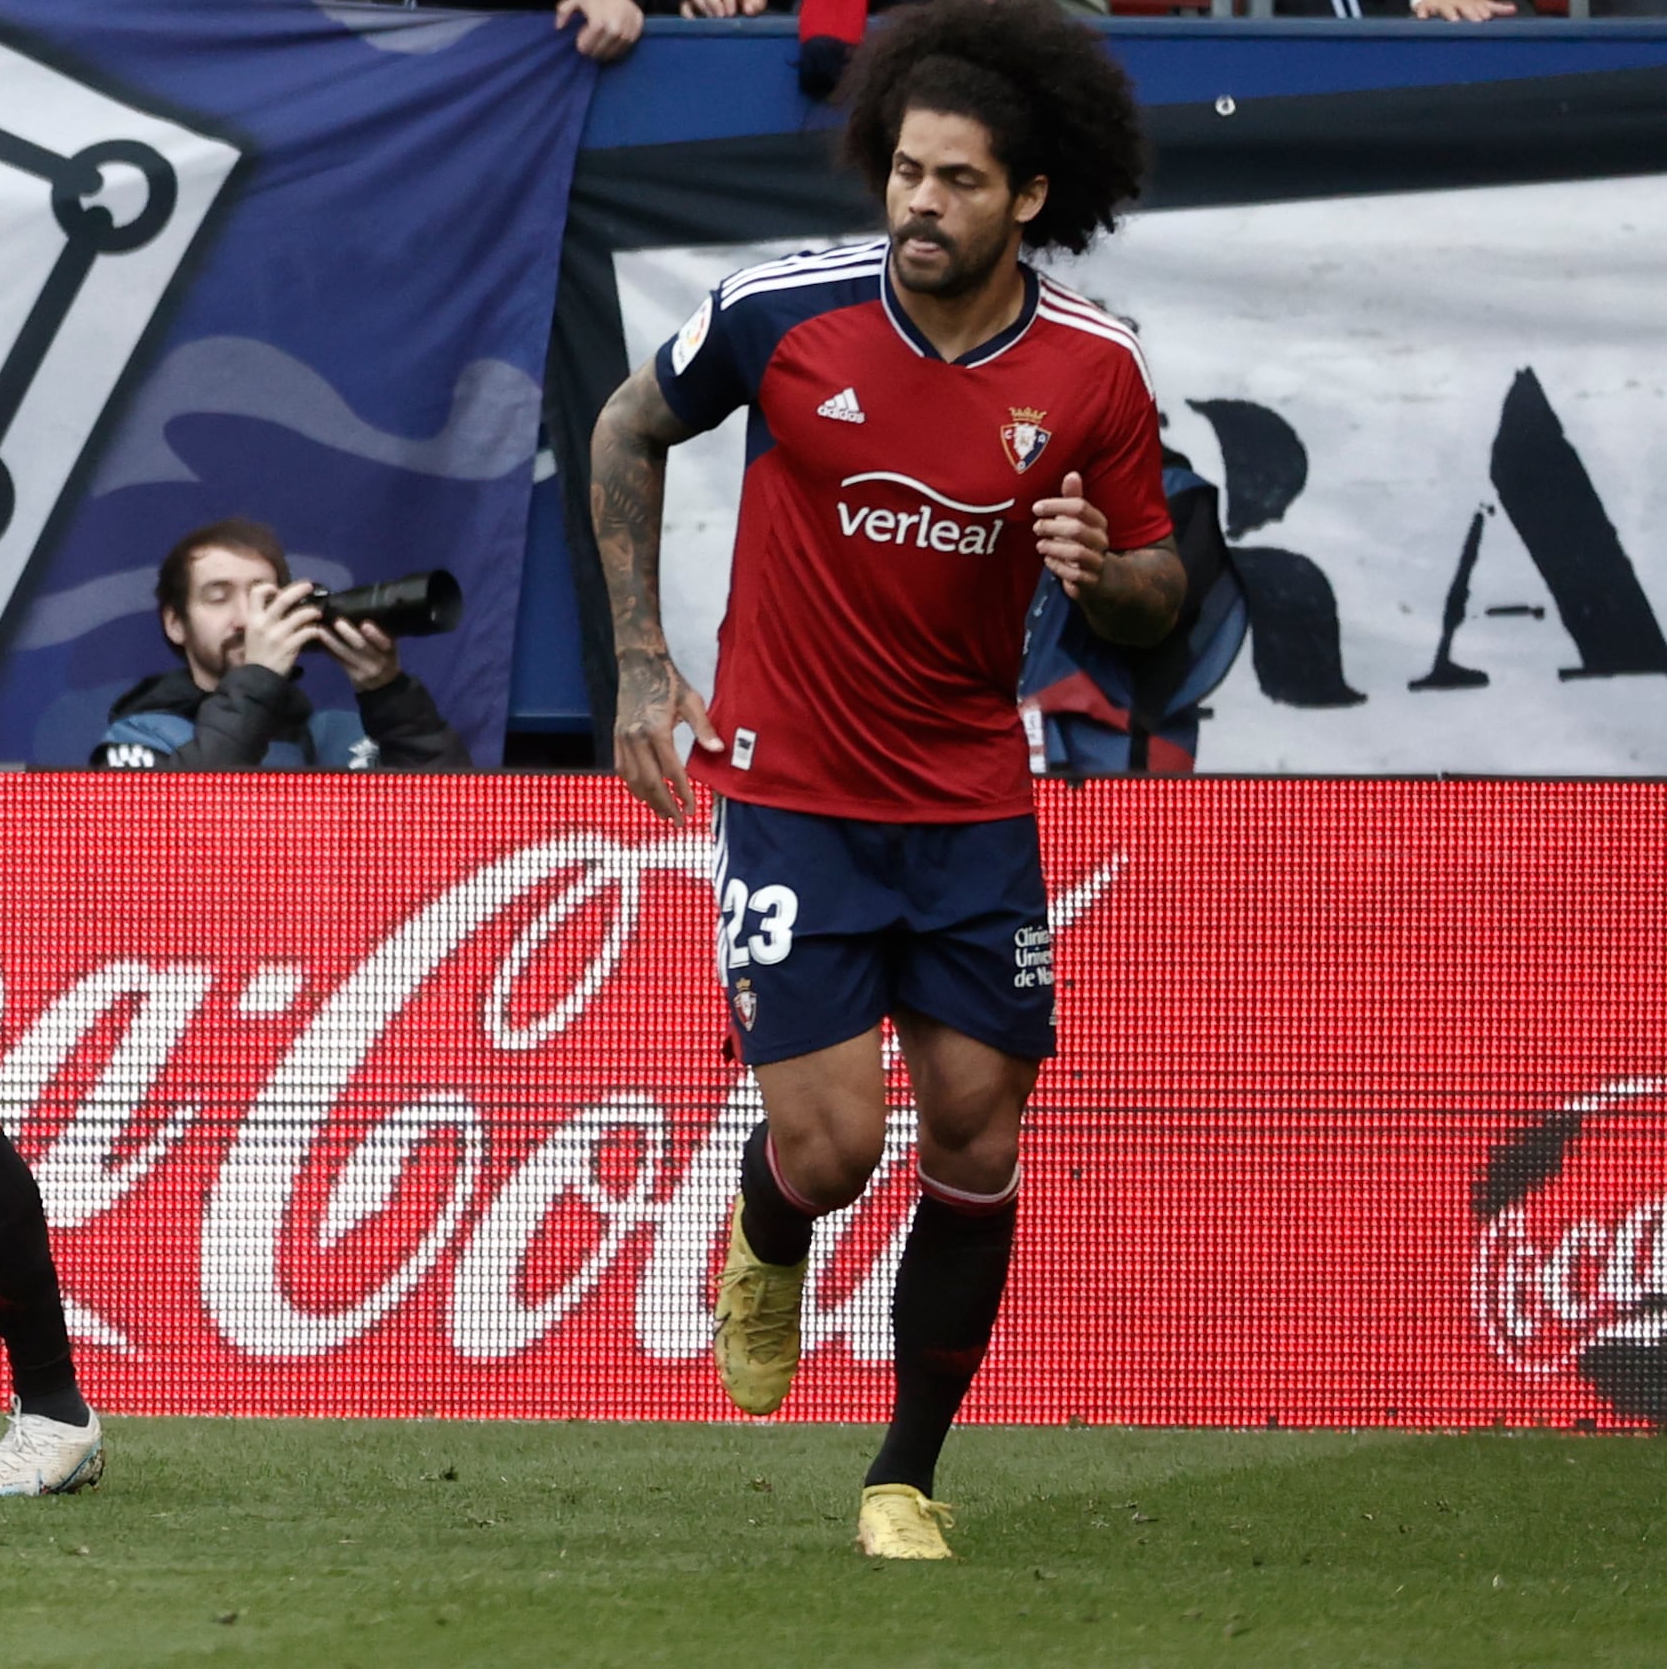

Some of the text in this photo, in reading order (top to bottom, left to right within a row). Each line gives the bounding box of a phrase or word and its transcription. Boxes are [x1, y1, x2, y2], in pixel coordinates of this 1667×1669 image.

[816, 402, 867, 426] adidas
[836, 501, 1004, 556] verleal
[724, 877, 800, 971] 23
[1013, 969, 1036, 988] de
